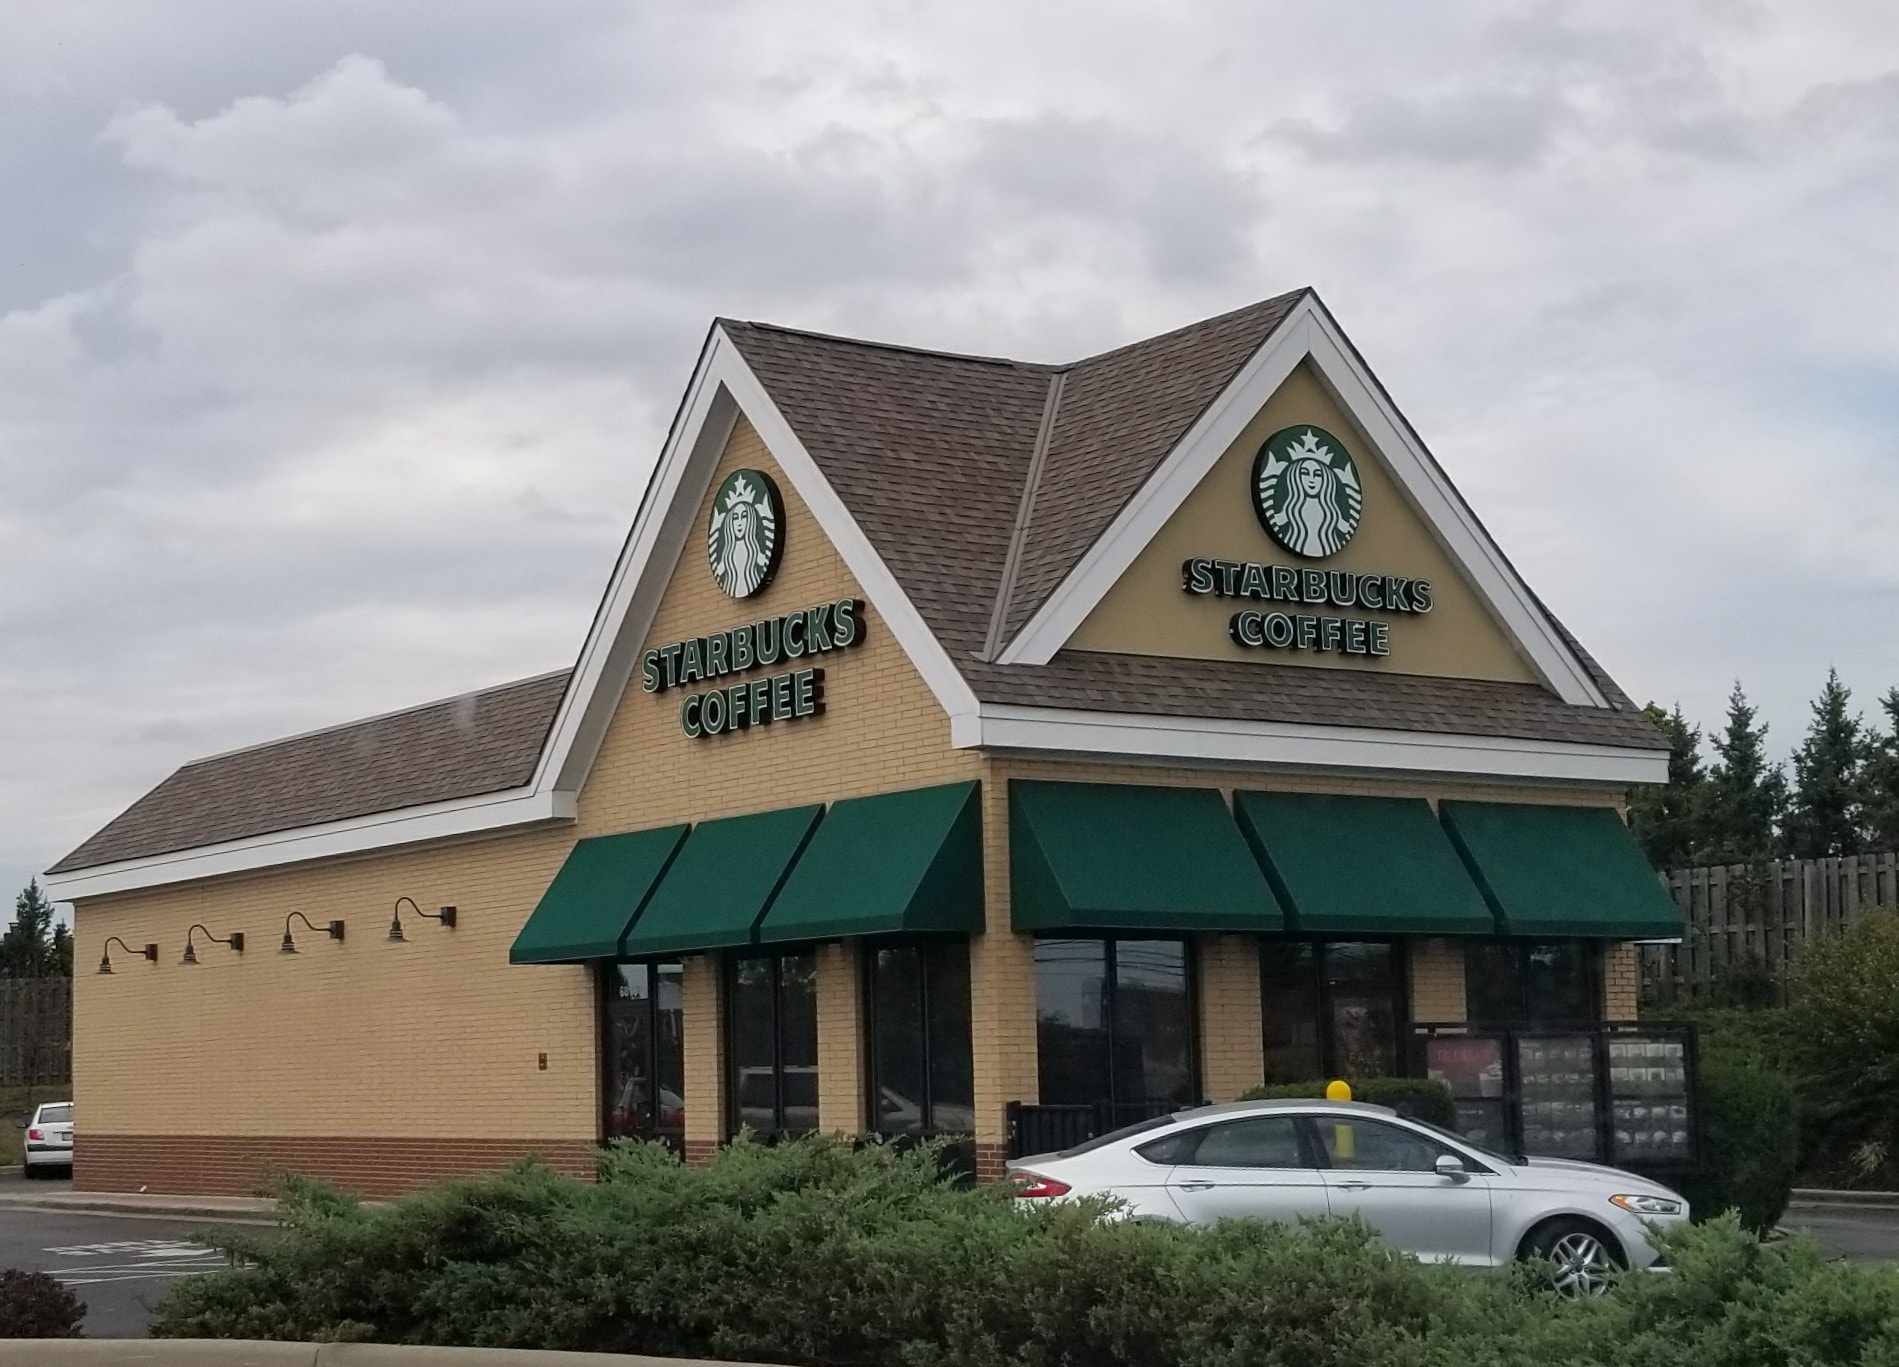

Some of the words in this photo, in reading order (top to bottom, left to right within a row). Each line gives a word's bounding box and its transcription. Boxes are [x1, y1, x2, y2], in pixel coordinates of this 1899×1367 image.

[1187, 557, 1433, 614] STARBUCKS
[641, 598, 861, 694] STARBUCKS
[1235, 610, 1390, 656] COFFEE
[680, 667, 819, 739] COFFEE
